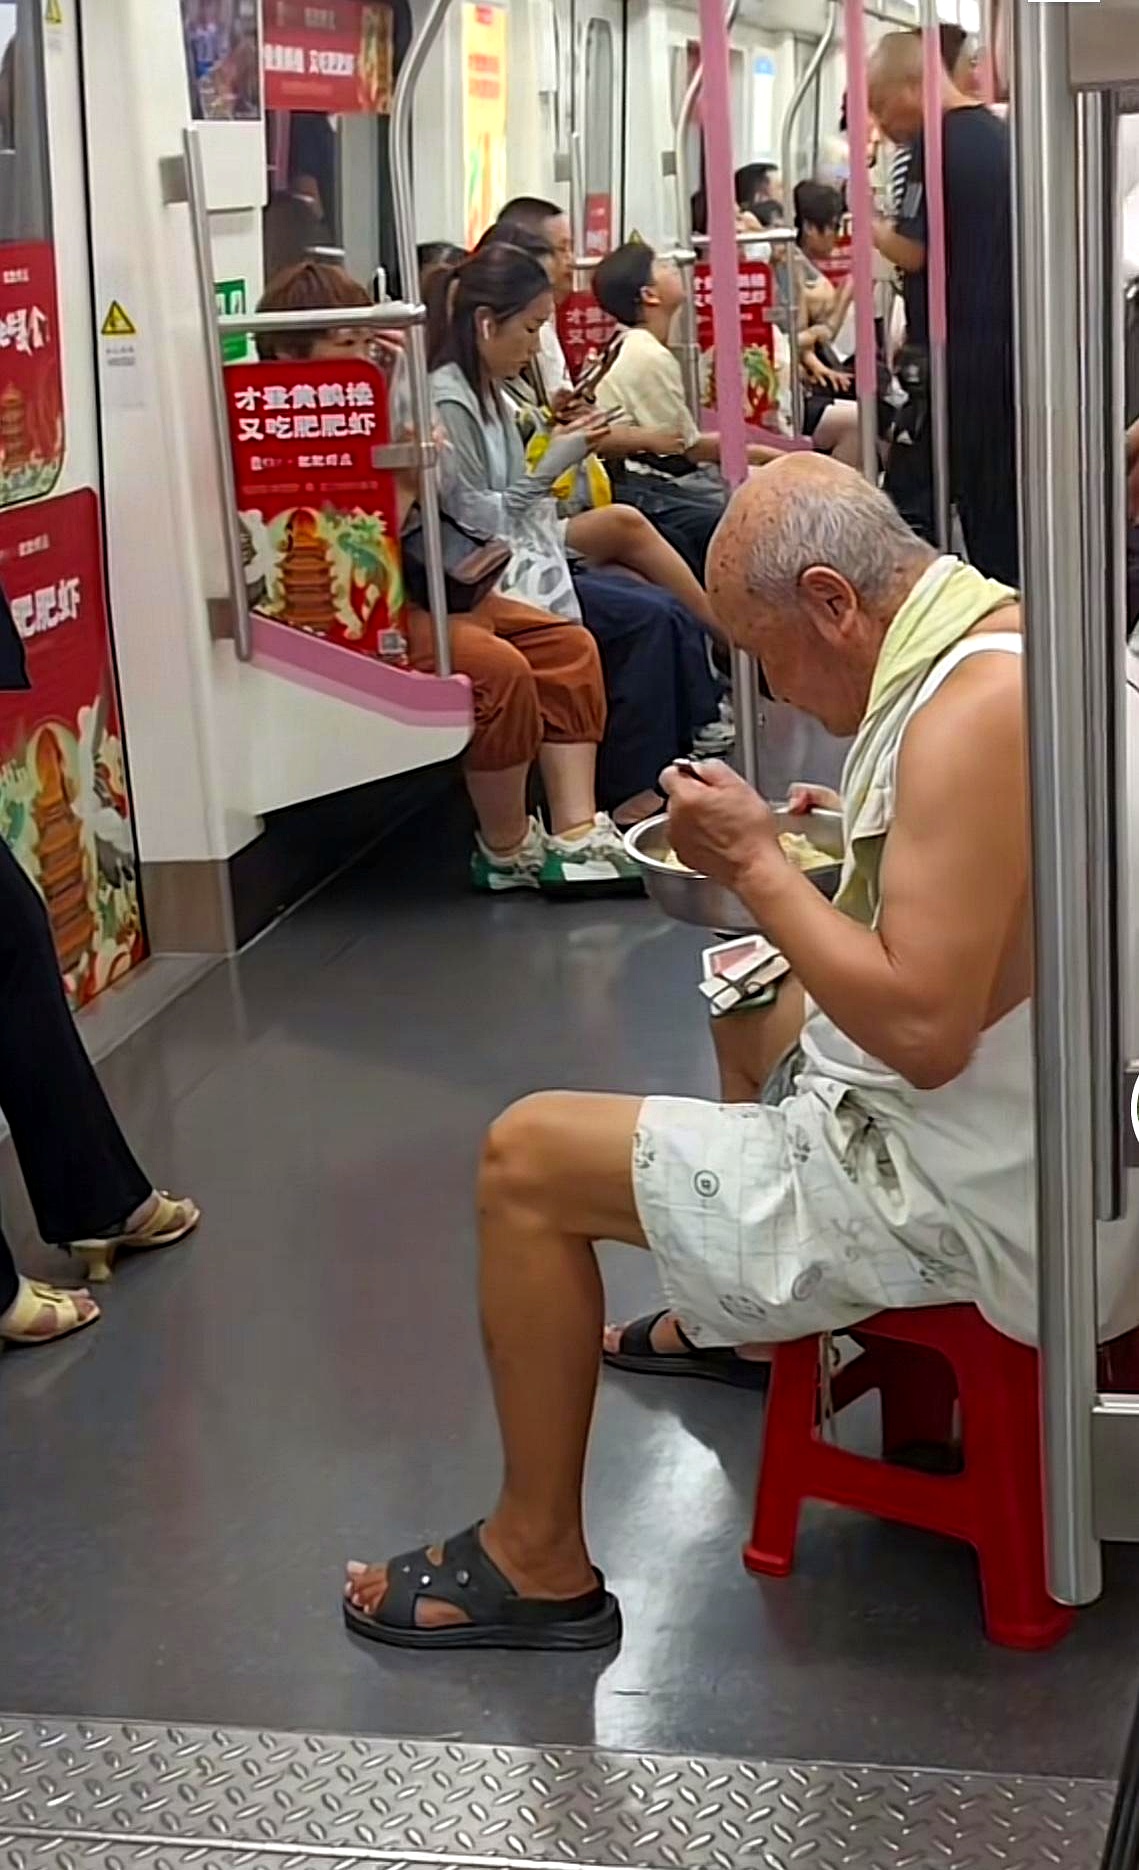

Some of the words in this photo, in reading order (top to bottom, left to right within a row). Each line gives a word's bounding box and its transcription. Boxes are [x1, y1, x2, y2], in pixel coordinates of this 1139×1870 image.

[237, 411, 377, 442] 又吃肥肥虾
